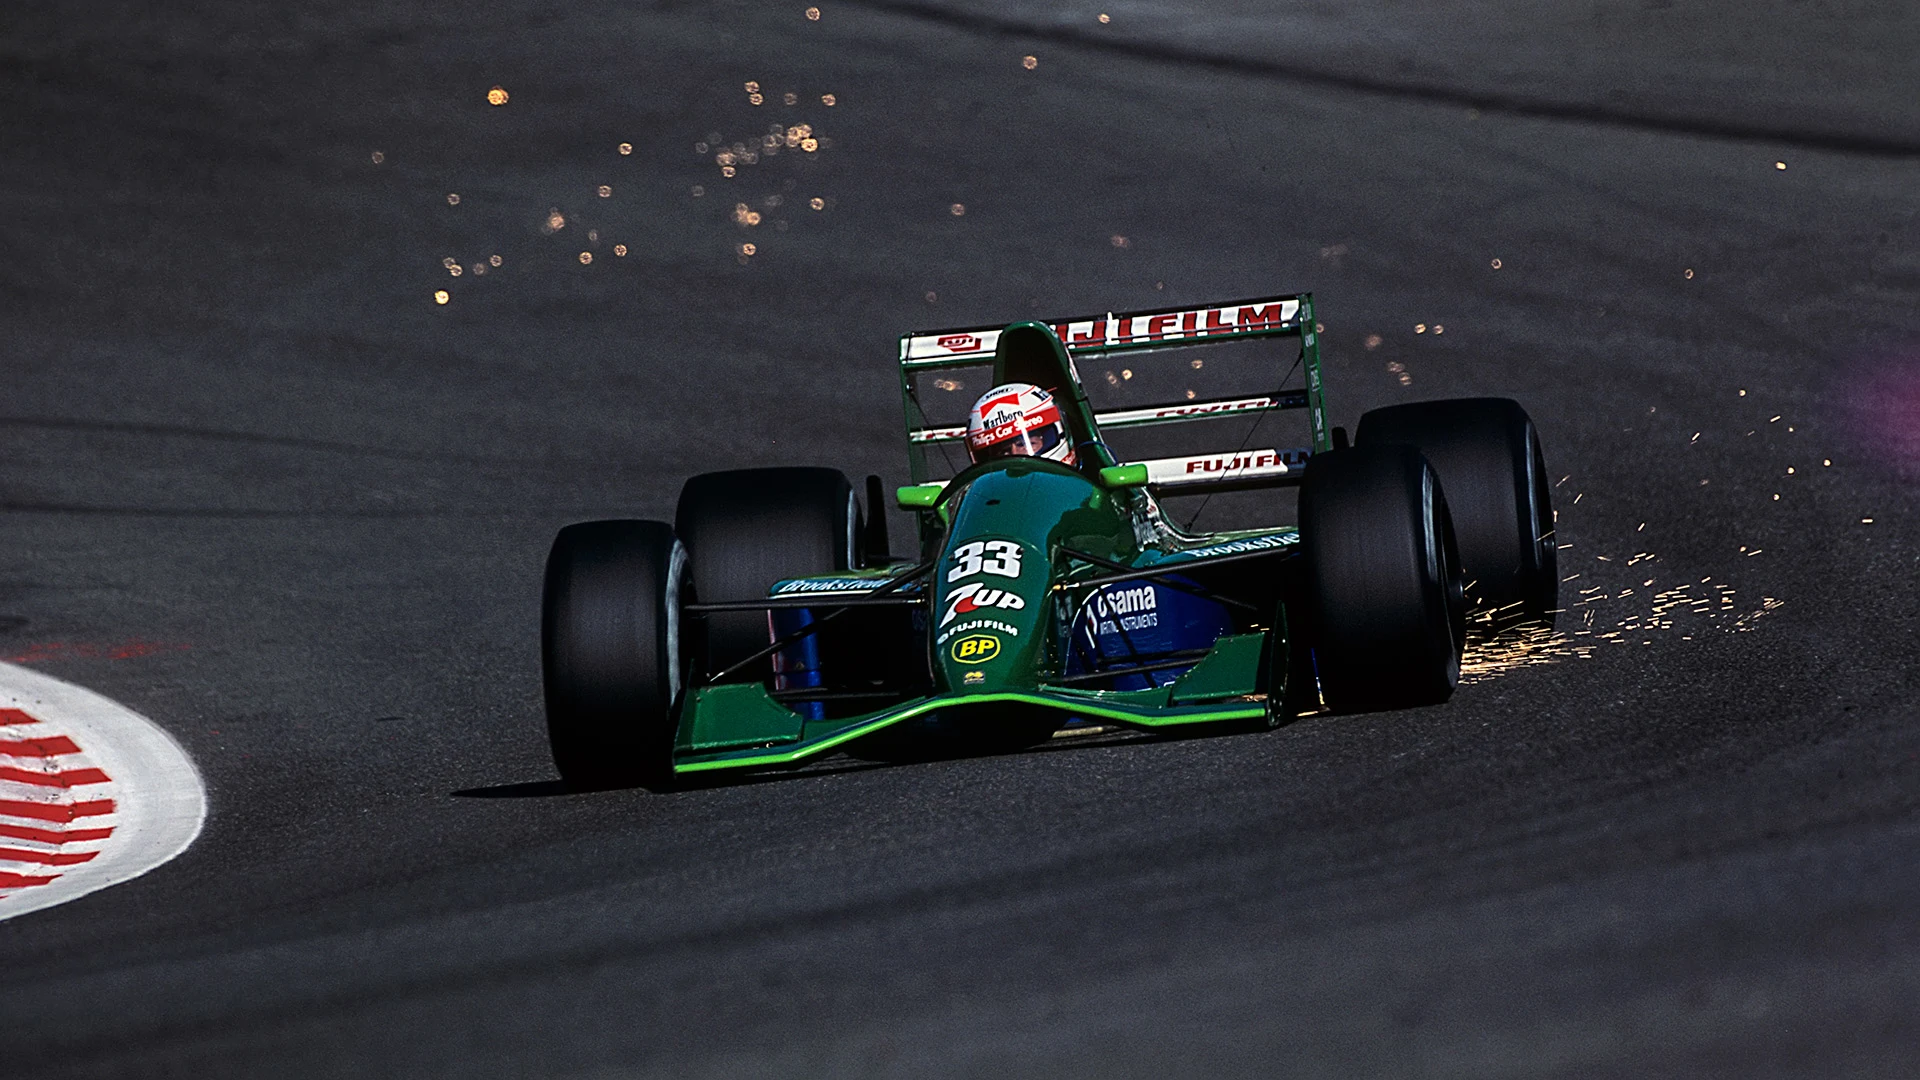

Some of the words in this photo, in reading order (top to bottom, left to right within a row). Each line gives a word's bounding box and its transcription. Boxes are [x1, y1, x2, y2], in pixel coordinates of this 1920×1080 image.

[983, 410, 1024, 430] Marlboro
[996, 425, 1013, 438] Car
[948, 540, 1022, 583] 33
[939, 582, 1025, 629] 7UP
[949, 620, 1018, 637] FUJIFILM
[959, 640, 995, 658] BP
